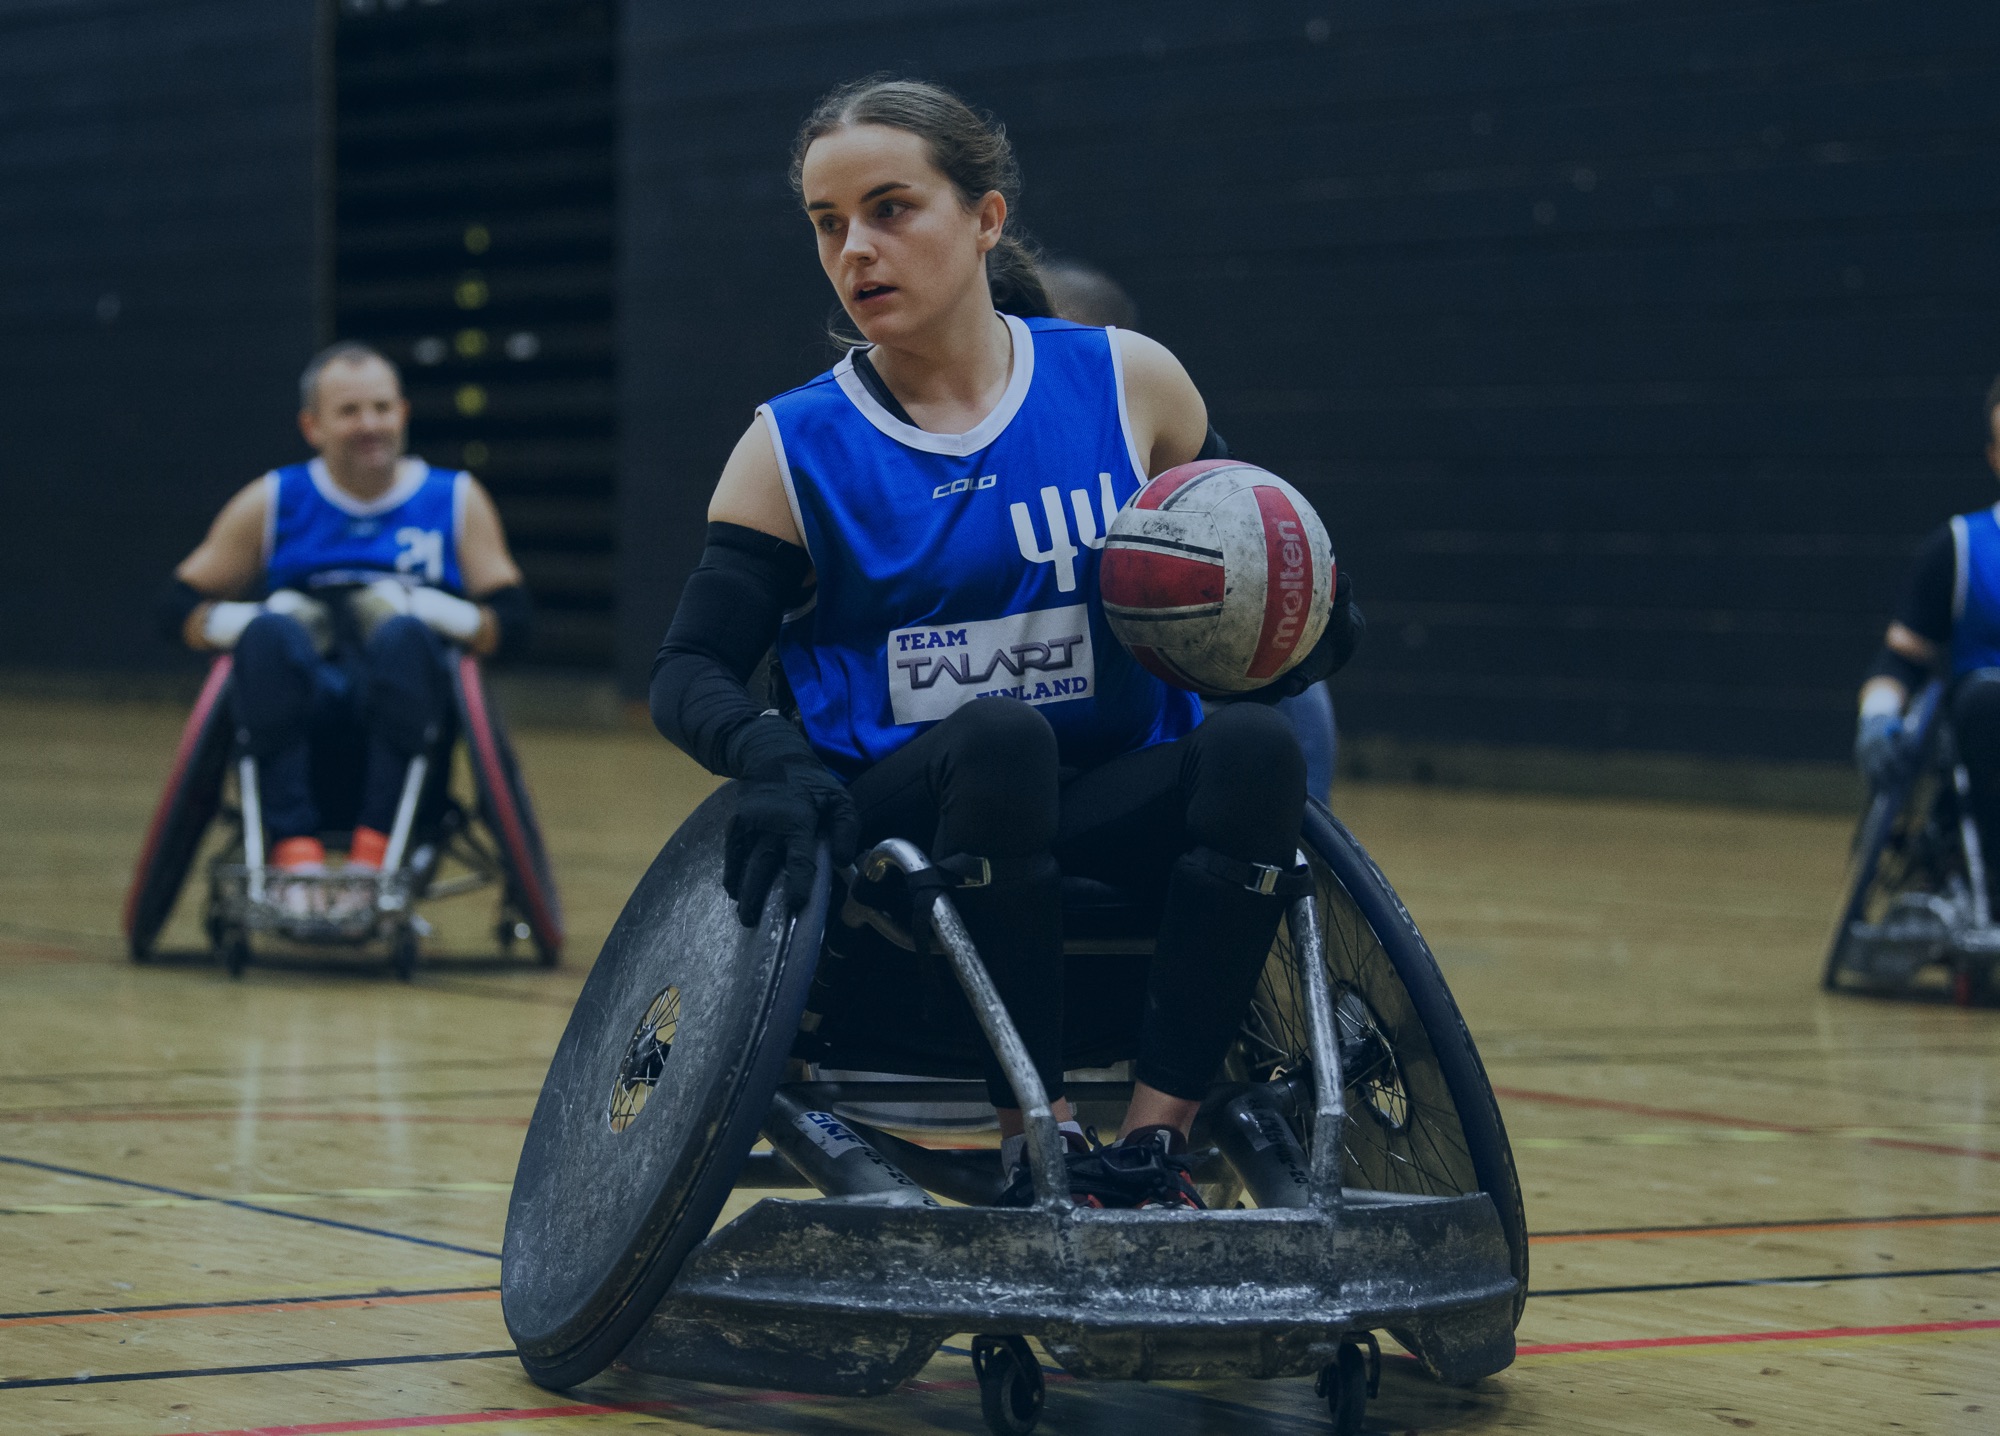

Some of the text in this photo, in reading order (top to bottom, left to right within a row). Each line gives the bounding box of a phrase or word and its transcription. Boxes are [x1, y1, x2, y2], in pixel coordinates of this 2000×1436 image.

[932, 474, 997, 499] COLO
[1271, 520, 1305, 650] molten
[896, 628, 968, 652] TEAM
[896, 634, 1084, 690] TALART
[976, 676, 1088, 701] NLAND
